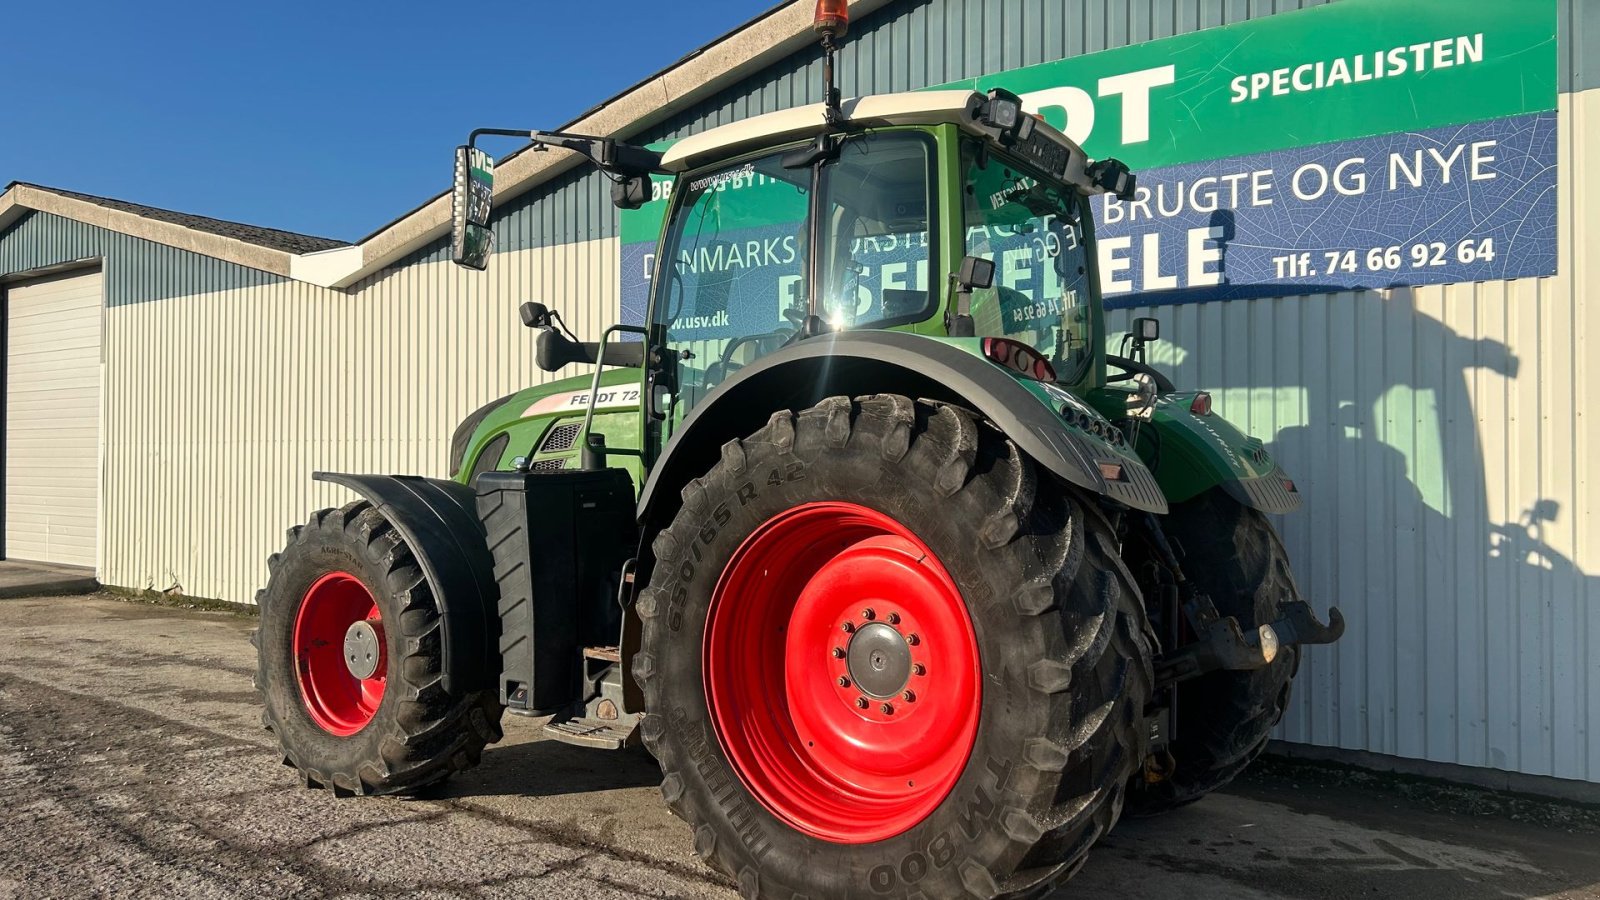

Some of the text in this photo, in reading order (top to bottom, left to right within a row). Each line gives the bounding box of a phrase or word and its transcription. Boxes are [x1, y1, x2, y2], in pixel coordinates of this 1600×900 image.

[1230, 33, 1484, 103] SPECIALISTEN
[643, 235, 795, 279] DNMARKS
[1103, 169, 1273, 224] BRUGTE
[1292, 157, 1366, 201] OG
[1389, 140, 1498, 191] NYE
[1272, 237, 1496, 279] Tlf. 74 66 92 64
[672, 310, 730, 330] w.usv.dk
[622, 390, 641, 401] 72
[736, 482, 760, 506] R
[767, 461, 806, 487] 42
[868, 831, 957, 895] 800
